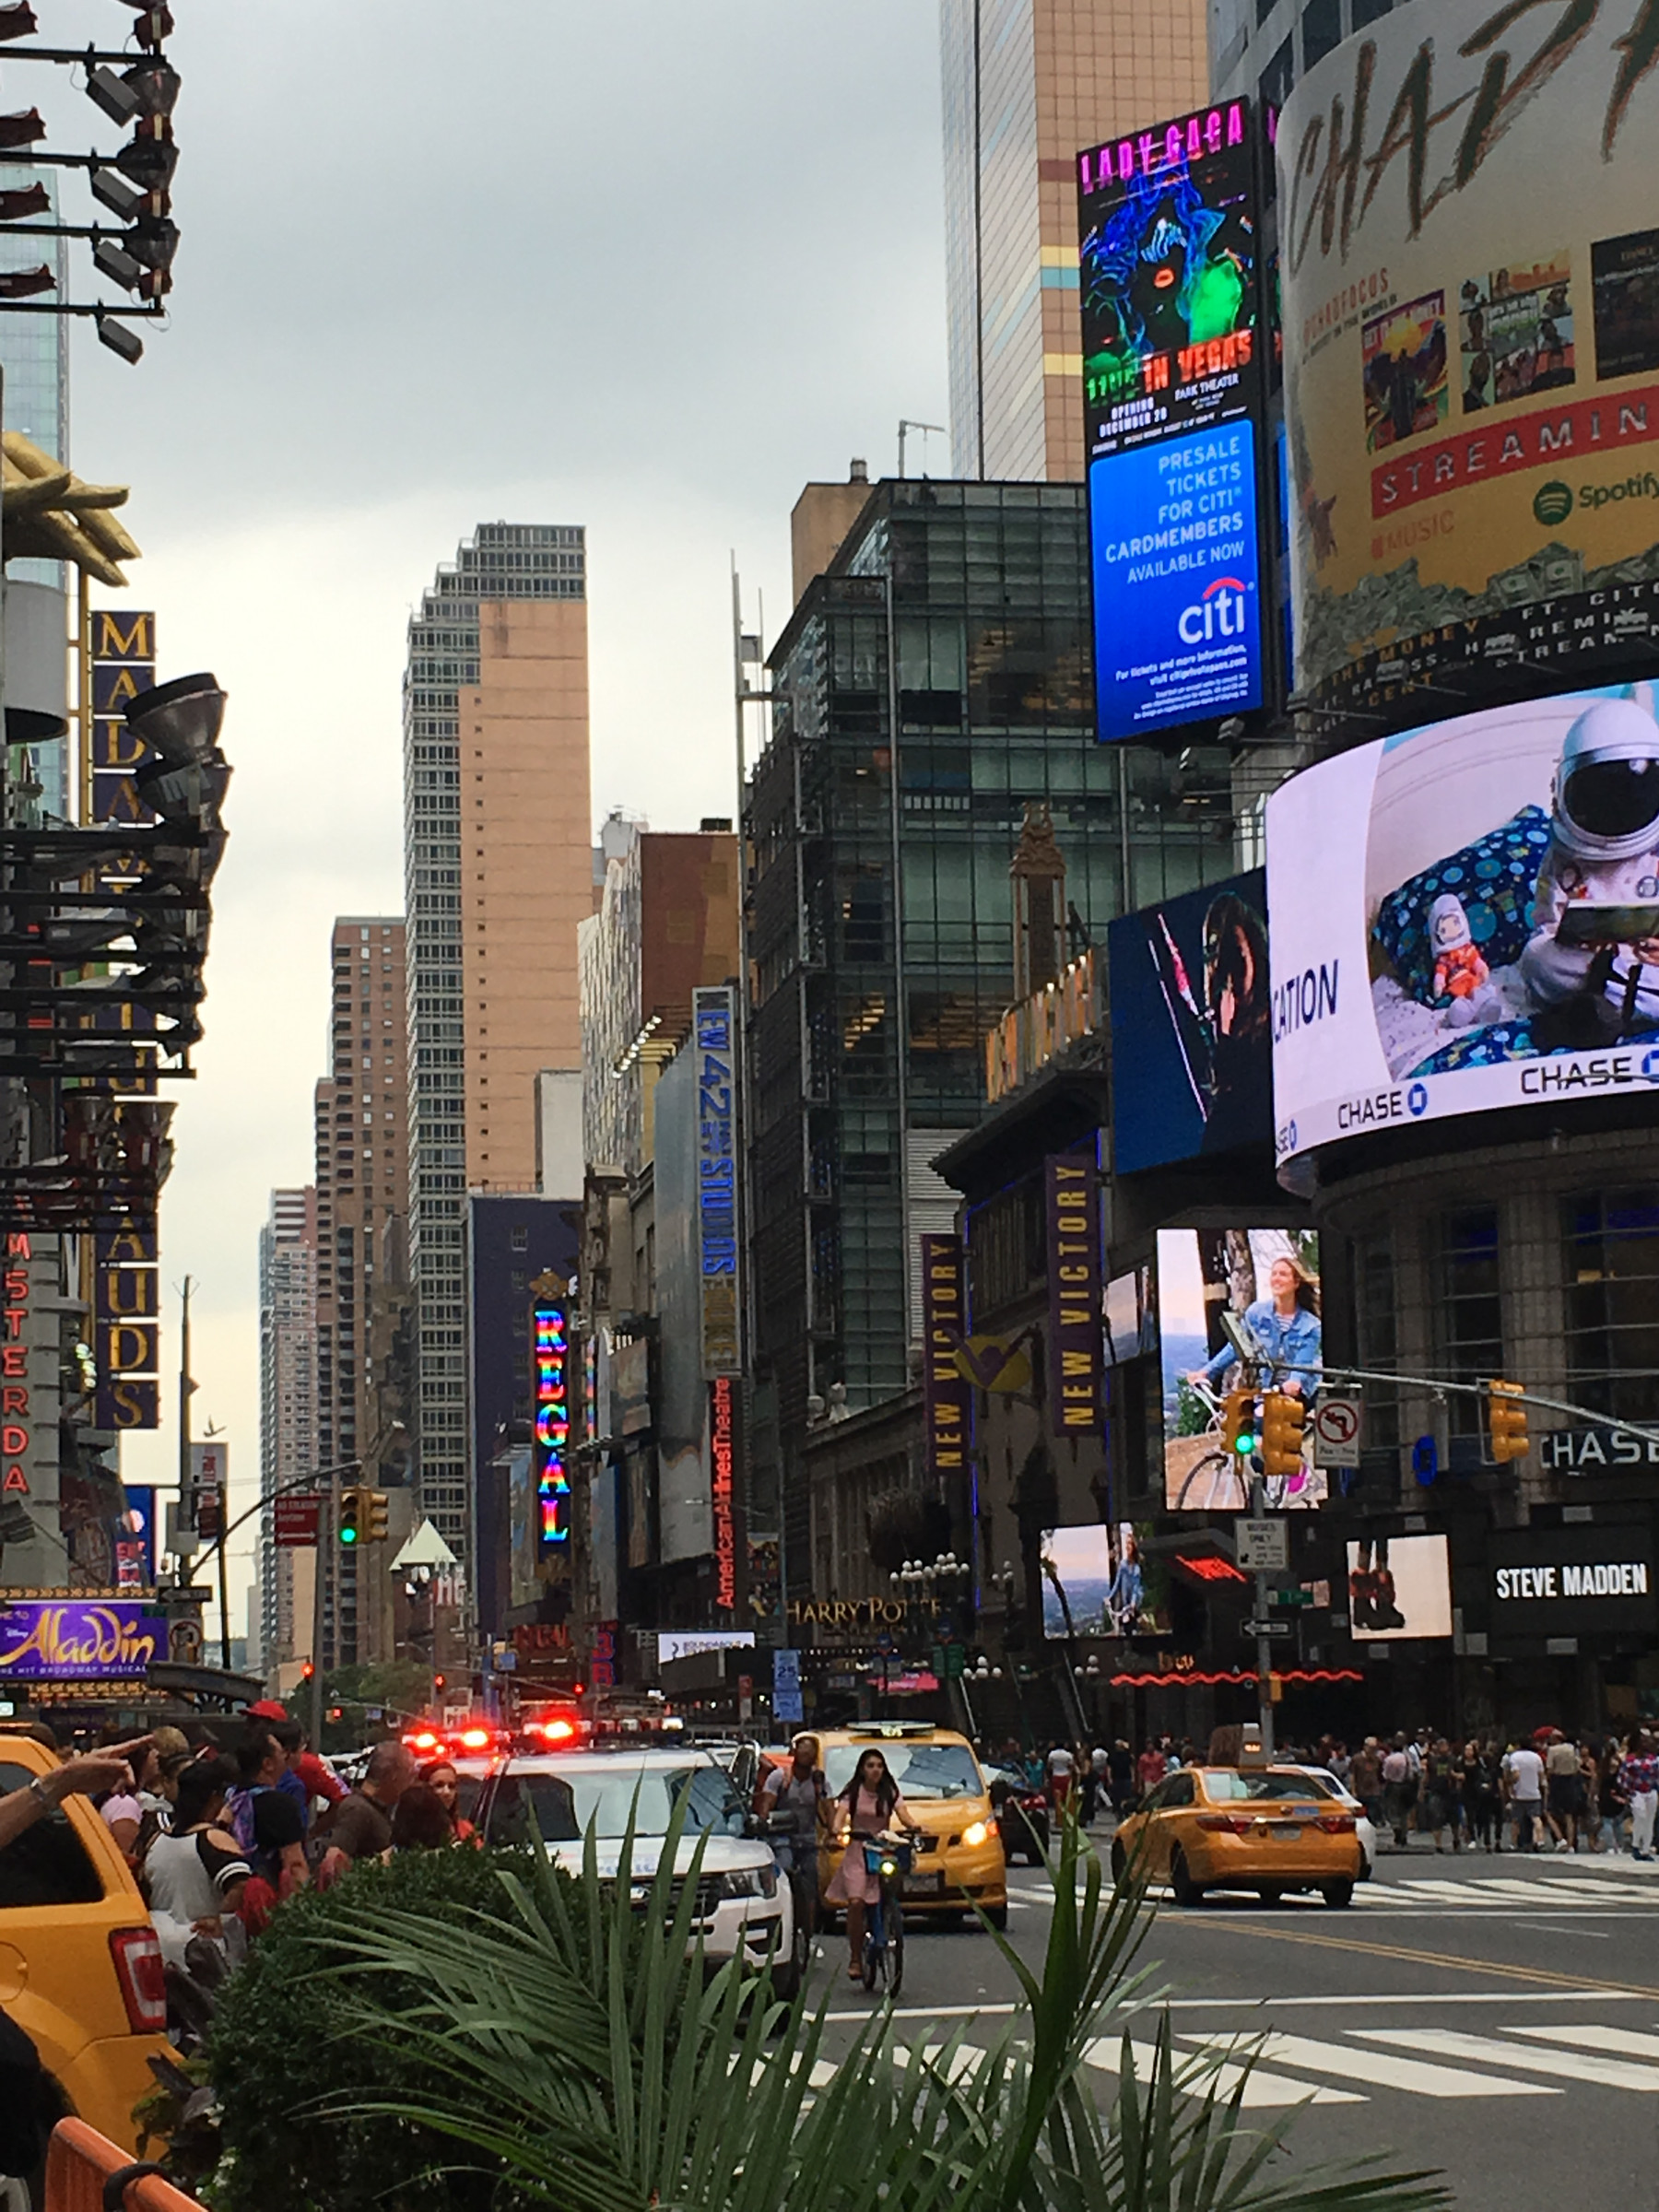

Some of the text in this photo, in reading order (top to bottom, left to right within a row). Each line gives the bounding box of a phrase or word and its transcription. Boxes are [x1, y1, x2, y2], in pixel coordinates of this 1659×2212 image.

[1081, 103, 1242, 195] LADY GAGA
[1178, 329, 1253, 382] VEGAS
[1099, 412, 1152, 438] DECEMBER
[1112, 396, 1155, 420] OPENING
[1159, 436, 1241, 475] PRESALE
[1166, 462, 1242, 497] TICKETS
[1159, 500, 1193, 524] FOR
[1387, 509, 1455, 552] MUSIC
[1106, 512, 1243, 563] CARDMEMBERS
[1127, 540, 1244, 584] AVAILABLE NOW
[1179, 586, 1245, 644] citi
[697, 991, 731, 1052] NEW
[1520, 1056, 1633, 1094] CHASE
[1337, 1089, 1403, 1129] CHASE
[700, 1158, 735, 1276] STUDIOS
[1056, 1165, 1095, 1427] NEW VICTORY
[930, 1242, 962, 1468] NEW VICTORY
[535, 1310, 571, 1543] REGAL
[1496, 1563, 1648, 1599] STEVE MADDEN
[786, 1599, 868, 1626] HARRY
[0, 1606, 155, 1665] Aladdin
[40, 1665, 99, 1675] BROADWAY
[102, 1664, 147, 1674] MUSICAL
[778, 1665, 796, 1677] 25
